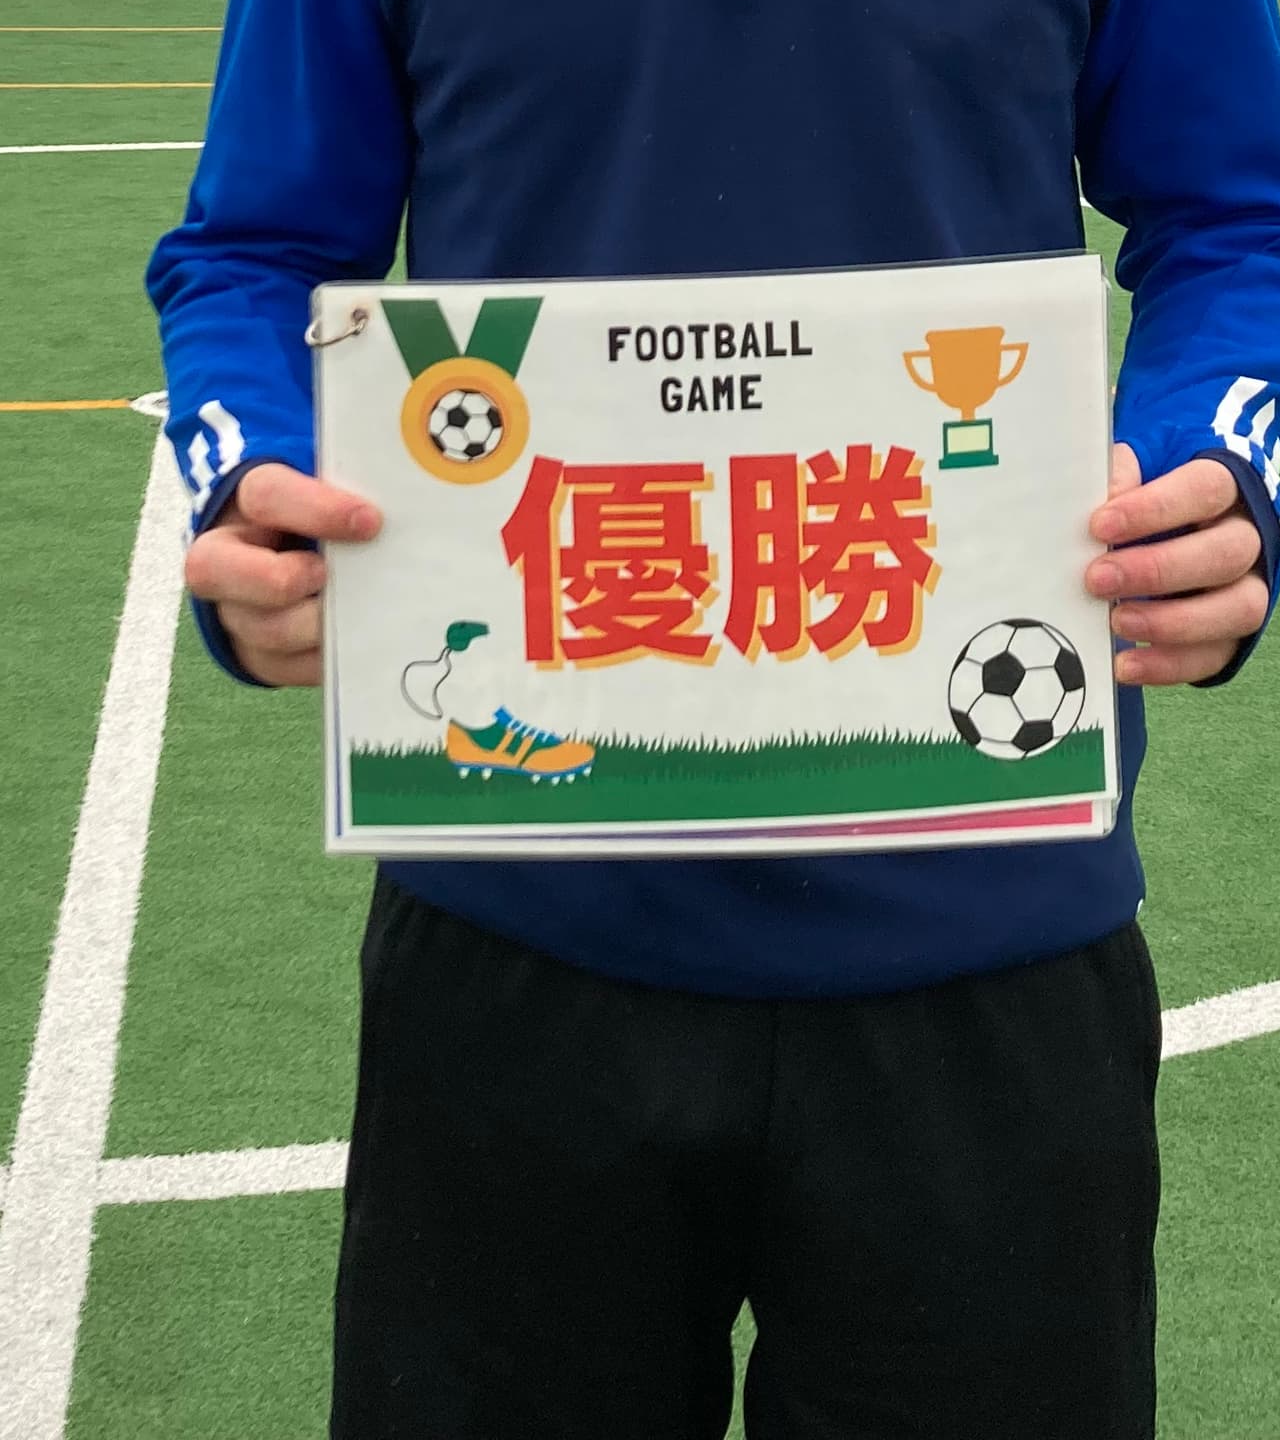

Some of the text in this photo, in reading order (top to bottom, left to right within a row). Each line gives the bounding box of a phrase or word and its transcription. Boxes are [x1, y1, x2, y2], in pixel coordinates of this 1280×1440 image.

[607, 320, 813, 362] FOOTBALL
[659, 375, 764, 413] GAME
[500, 444, 938, 671] 優勝
